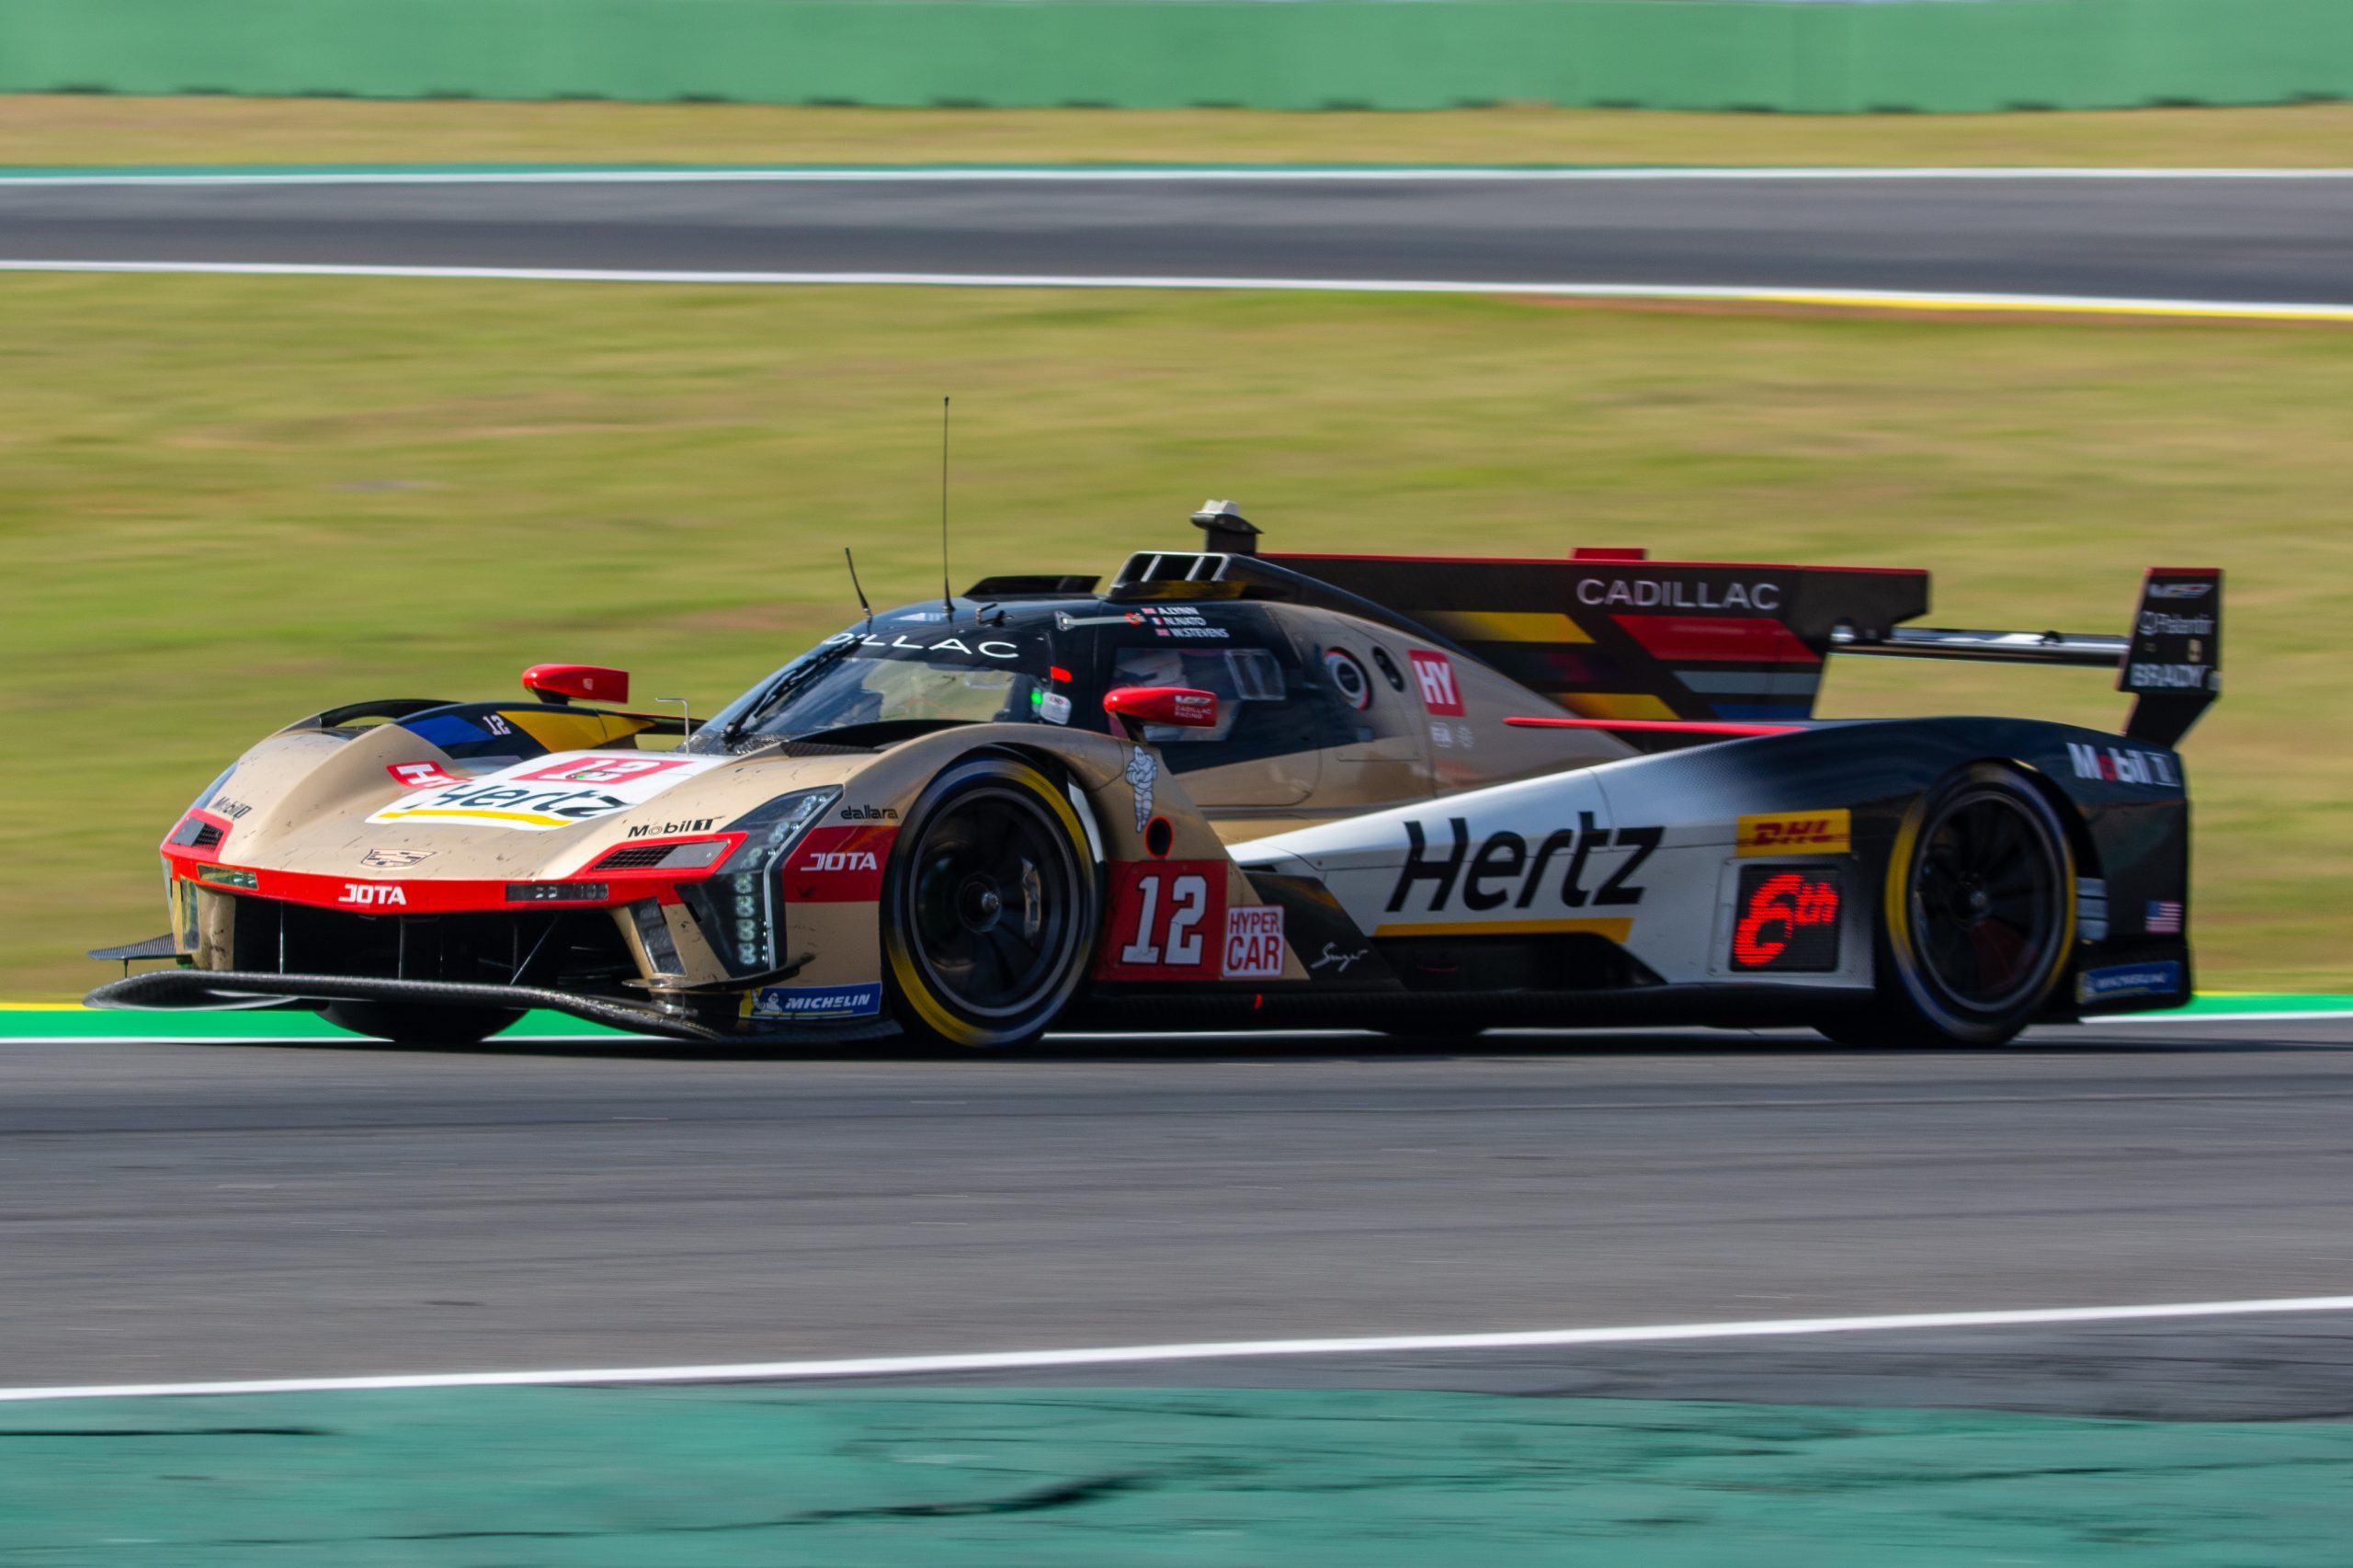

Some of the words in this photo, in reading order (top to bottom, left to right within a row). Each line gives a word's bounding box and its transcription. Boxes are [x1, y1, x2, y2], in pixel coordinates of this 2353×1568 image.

[1575, 578, 1780, 610] CADILLAC
[1412, 660, 1457, 705] HY
[483, 714, 511, 735] 12
[538, 759, 662, 781] 12
[403, 785, 632, 817] Hertz
[841, 805, 898, 820] dallara
[628, 820, 692, 838] Mobil
[1754, 821, 1830, 845] DHL
[801, 852, 877, 871] JOTA
[1384, 811, 1666, 912] Hertz
[338, 883, 407, 905] JOTA
[1121, 875, 1207, 965] 12
[1229, 912, 1280, 934] HYPER
[1227, 936, 1279, 971] CAR
[785, 994, 870, 1009] MICHELIN
